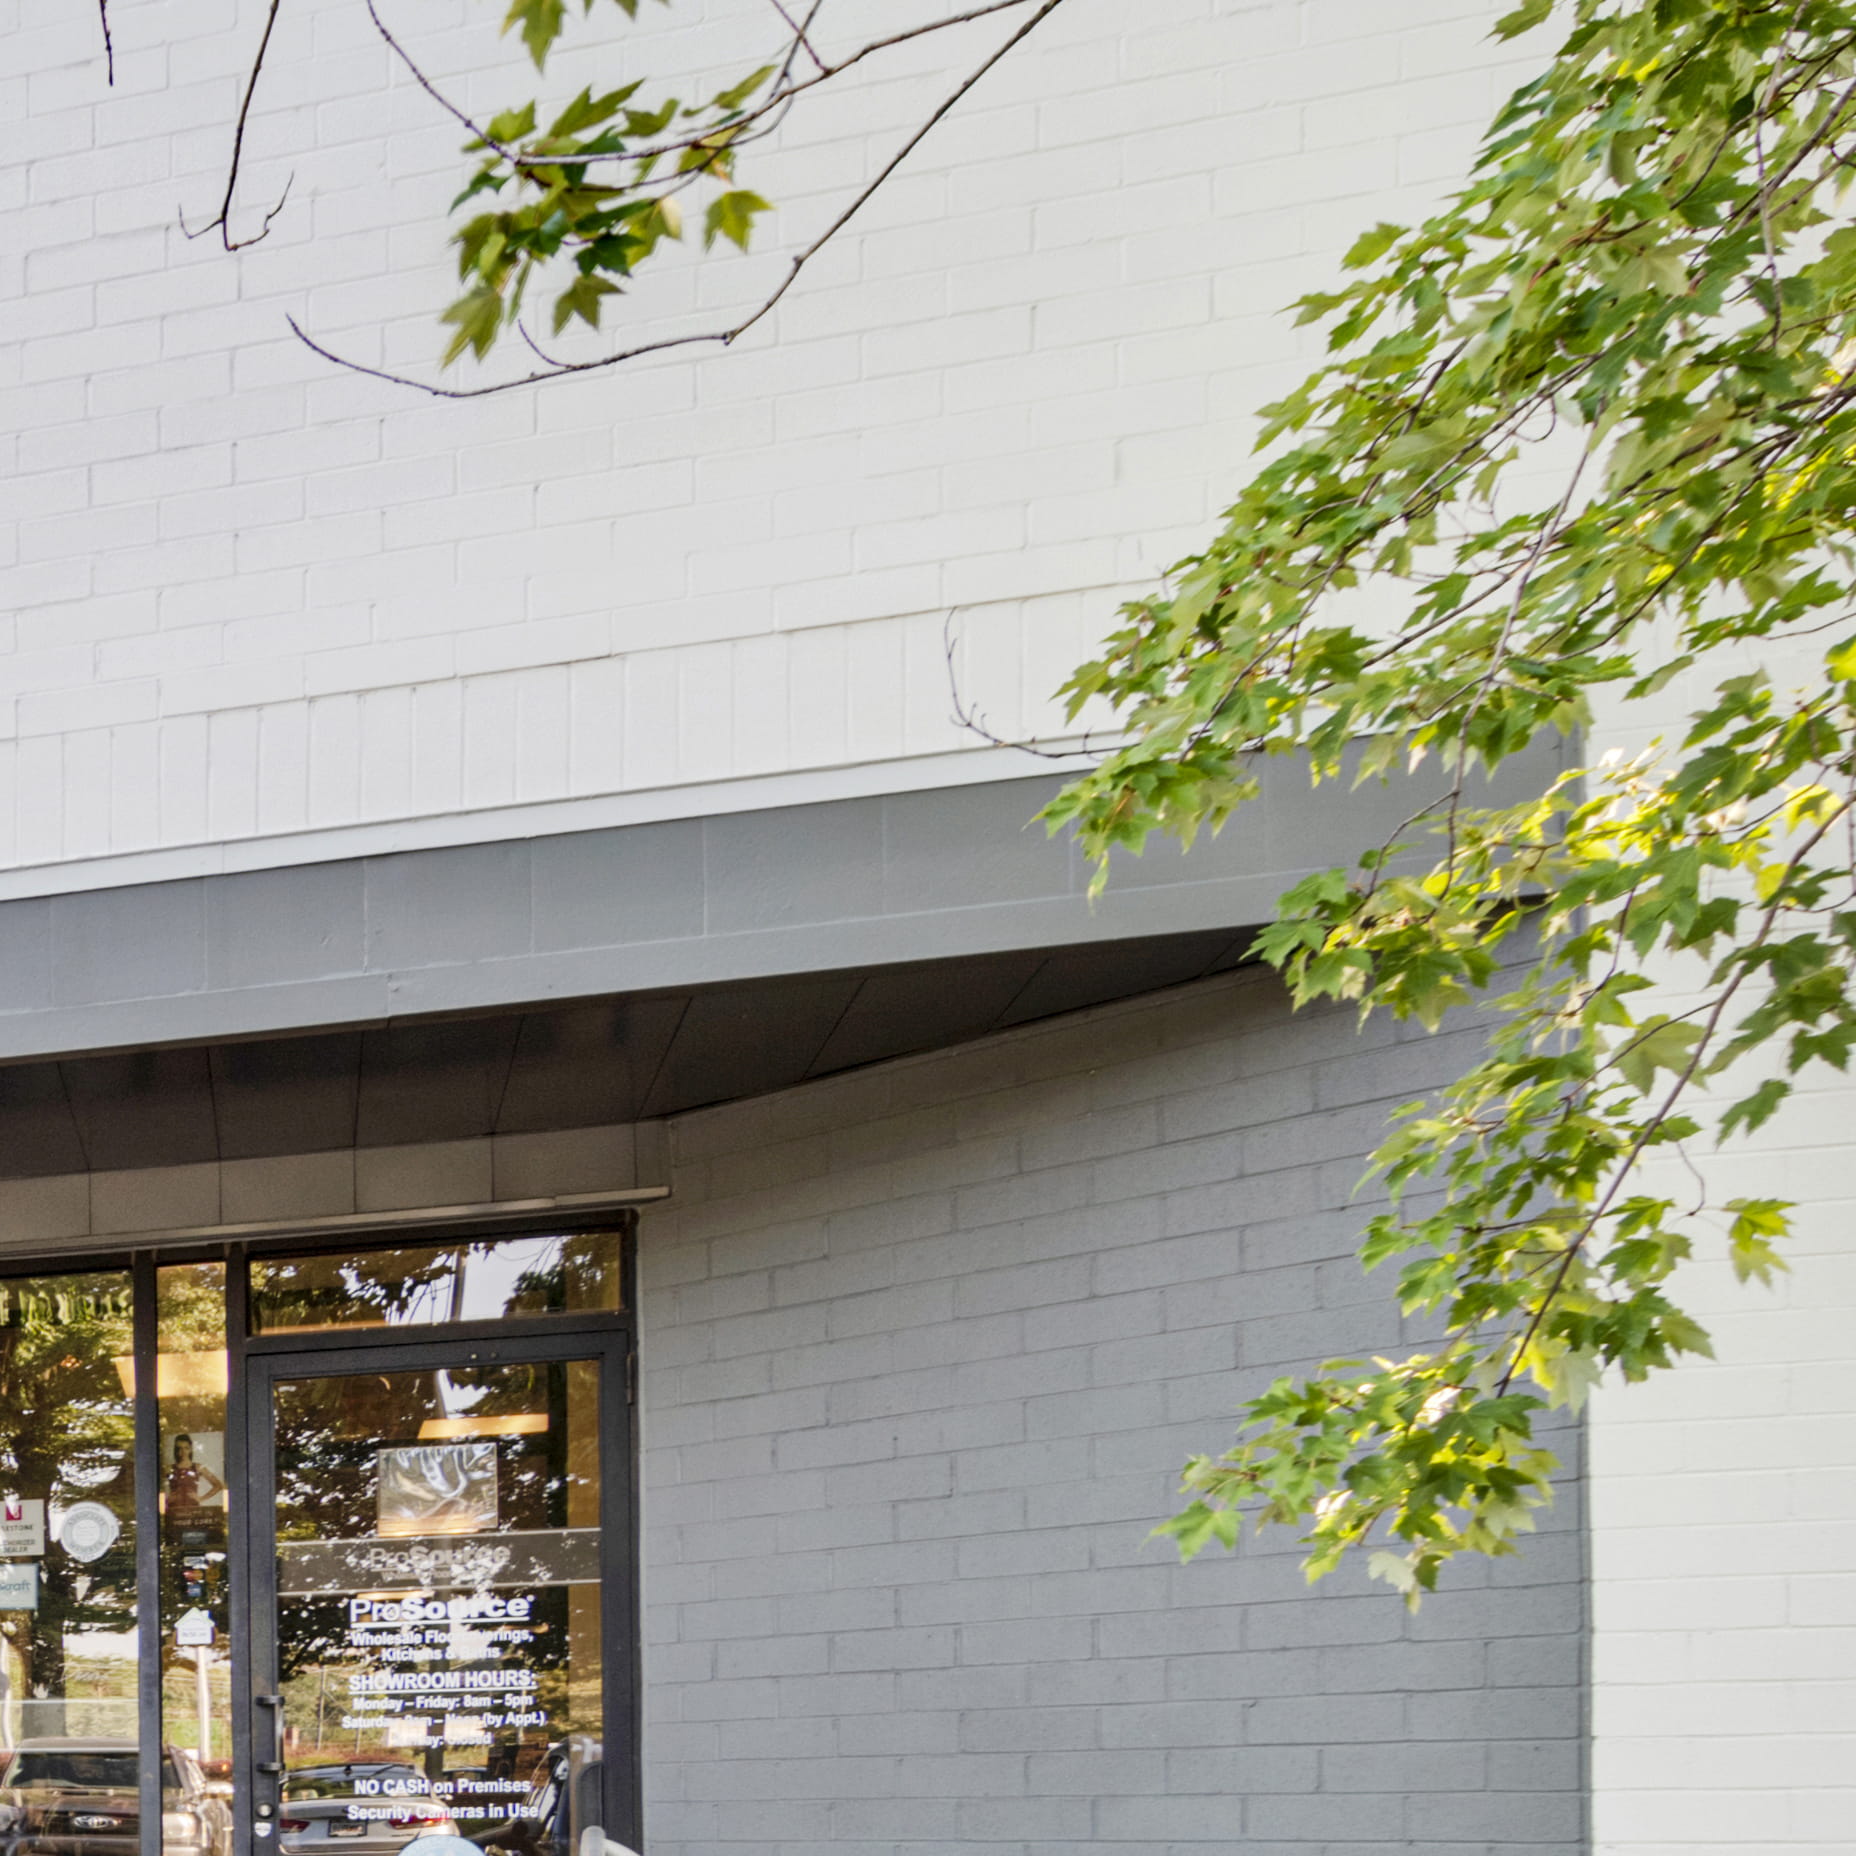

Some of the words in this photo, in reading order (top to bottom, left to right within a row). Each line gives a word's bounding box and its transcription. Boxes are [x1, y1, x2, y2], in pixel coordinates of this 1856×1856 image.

[351, 1631, 422, 1646] Wholesale
[425, 1629, 534, 1644] Flooverings,
[349, 1672, 460, 1690] SHOWROOM
[465, 1669, 536, 1686] HOURS:
[353, 1697, 404, 1712] Monday
[416, 1696, 460, 1710] Friday:
[464, 1695, 492, 1706] 8am
[505, 1694, 533, 1708] 5pm
[505, 1711, 545, 1727] Appt.)
[354, 1780, 380, 1794] NO
[382, 1779, 429, 1794] CASH
[433, 1782, 453, 1793] on
[457, 1778, 532, 1793] Premises
[347, 1805, 414, 1822] Security
[415, 1803, 485, 1819] Cameras
[489, 1803, 504, 1817] in
[507, 1803, 538, 1818] Use
